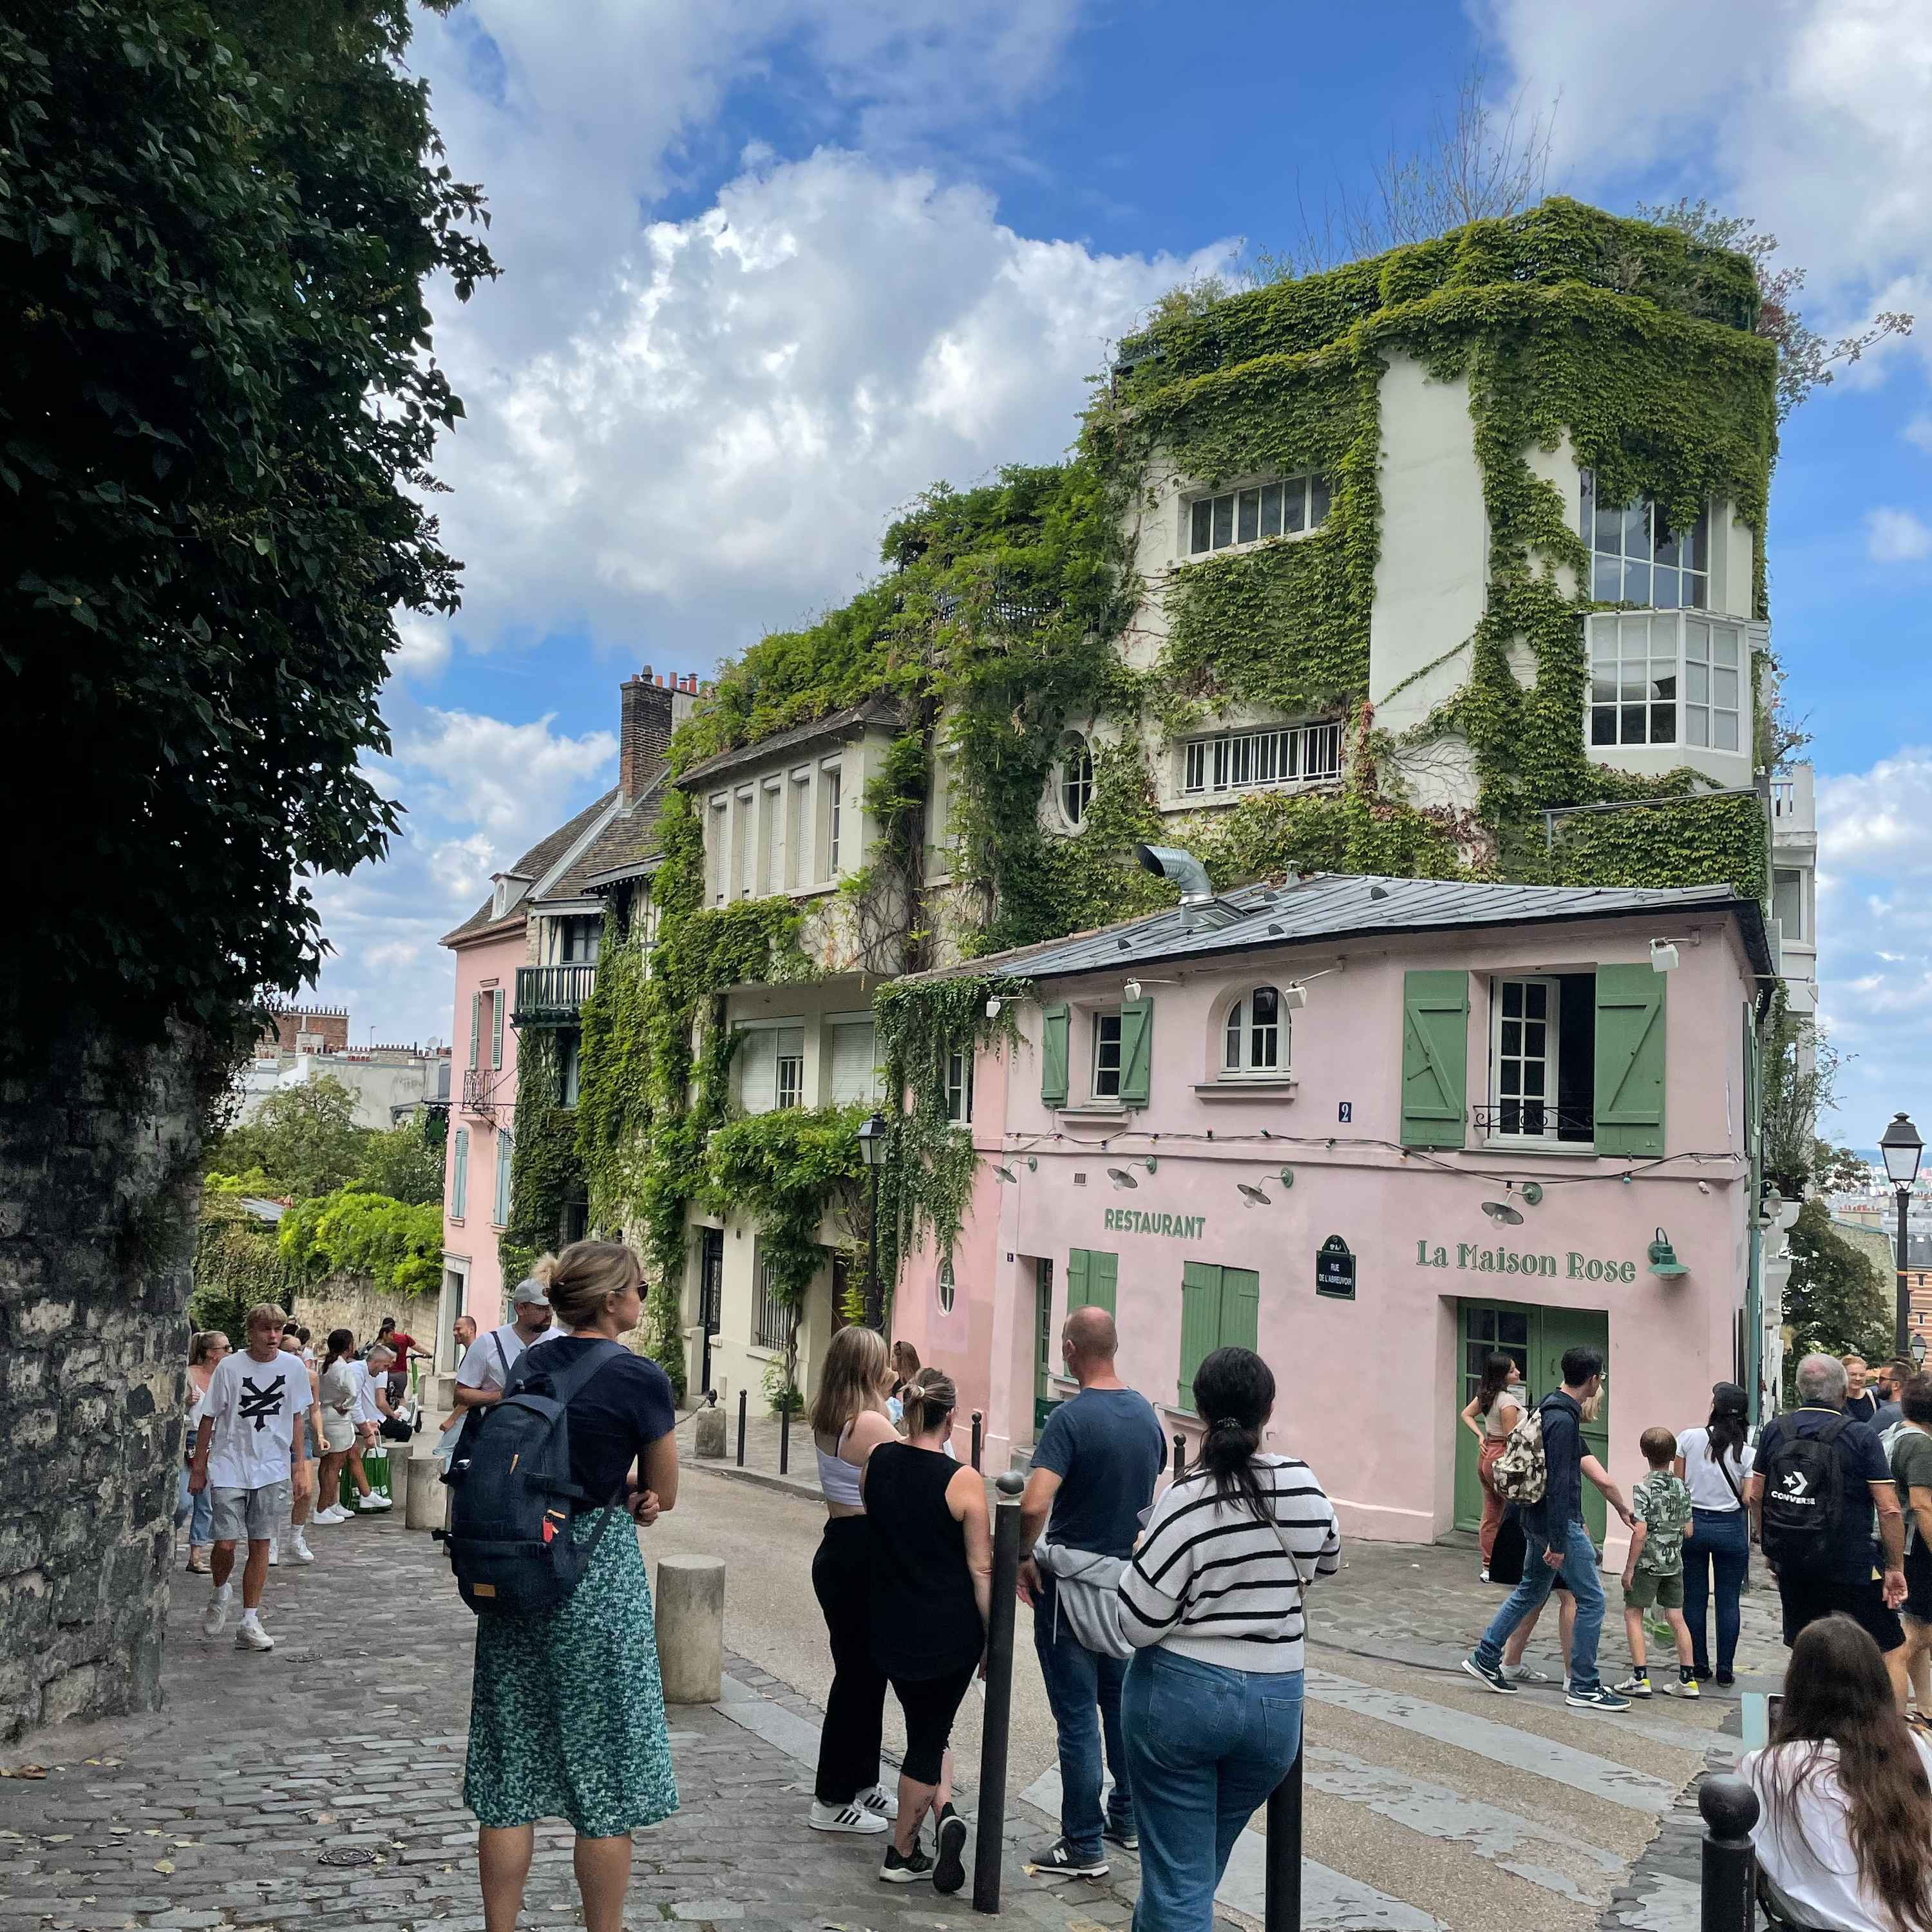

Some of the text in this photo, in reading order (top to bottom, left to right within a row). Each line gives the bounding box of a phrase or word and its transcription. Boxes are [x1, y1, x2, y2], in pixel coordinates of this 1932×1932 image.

[1341, 1103, 1349, 1121] 2
[1104, 1208, 1206, 1240] RESTAURANT
[1331, 1263, 1340, 1272] RUE
[1416, 1240, 1636, 1283] La Maison Rose
[1319, 1273, 1325, 1282] DE
